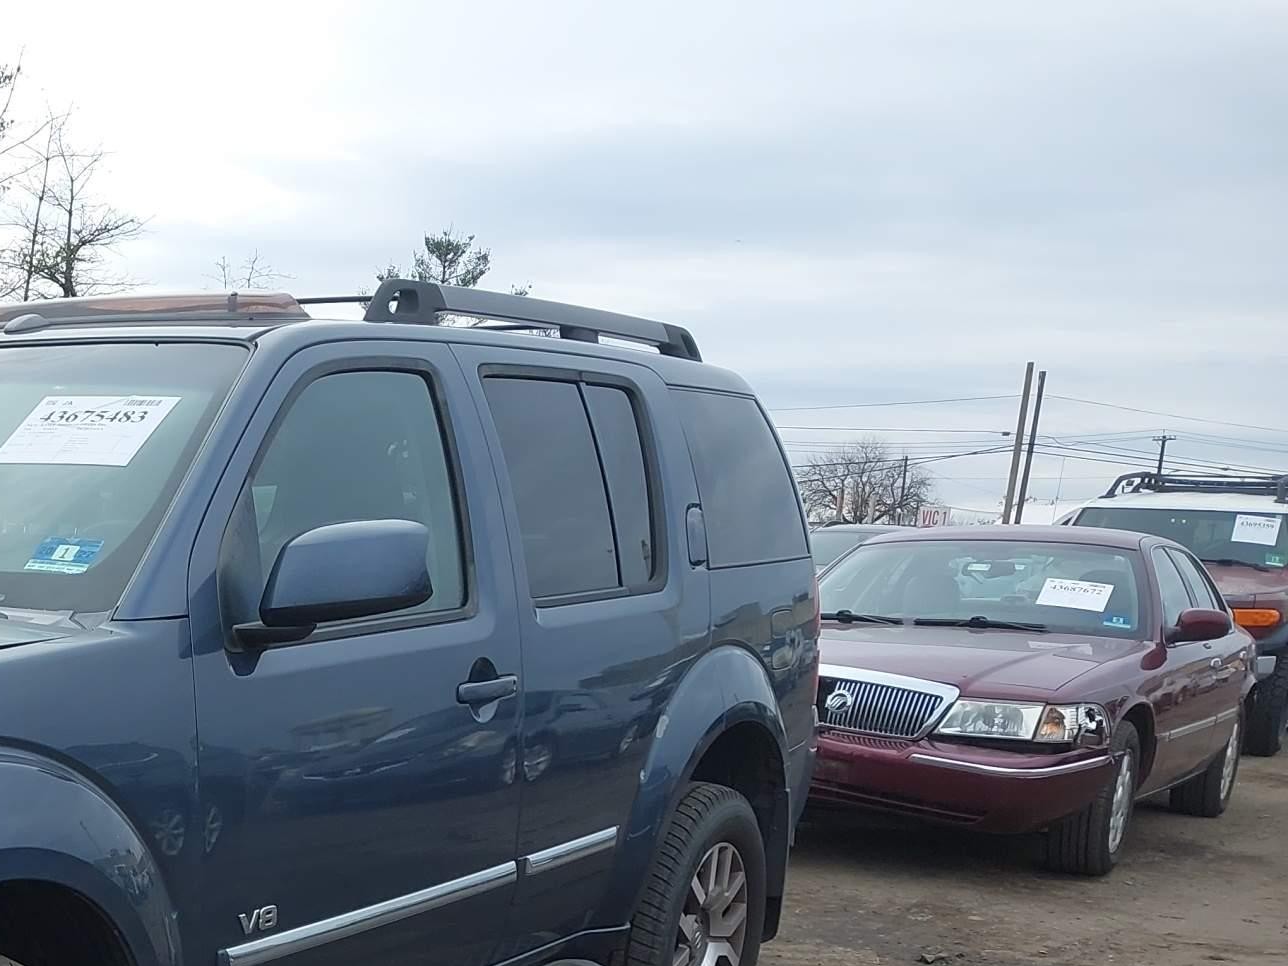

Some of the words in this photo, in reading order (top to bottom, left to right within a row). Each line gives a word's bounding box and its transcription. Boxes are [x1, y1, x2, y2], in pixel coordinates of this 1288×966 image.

[39, 410, 149, 423] 43675483
[922, 509, 940, 526] VIC
[58, 547, 71, 559] 1
[238, 904, 278, 935] V8
